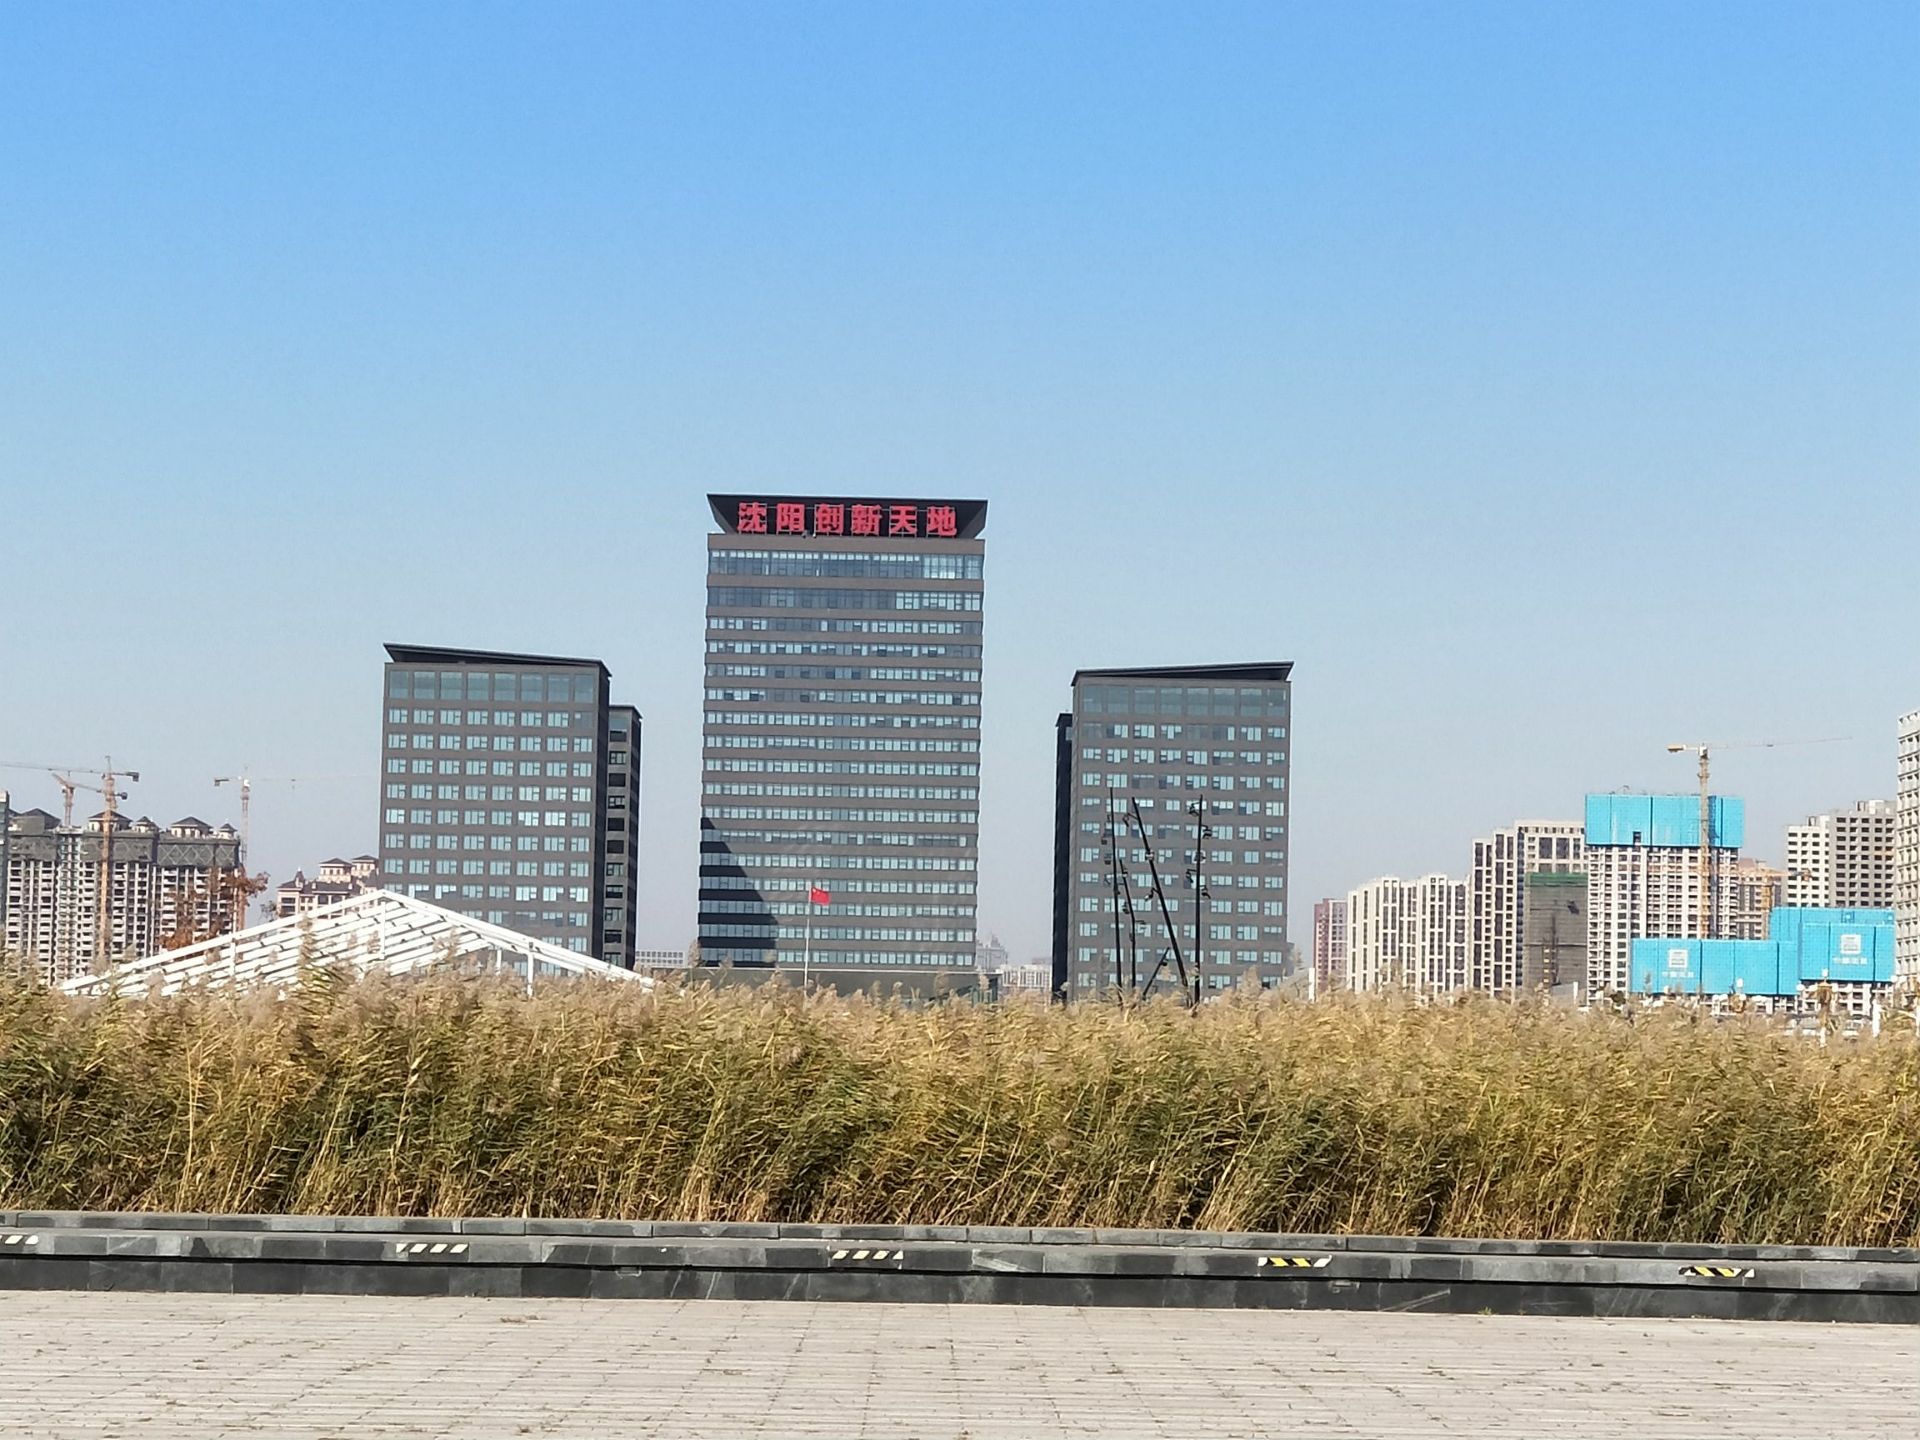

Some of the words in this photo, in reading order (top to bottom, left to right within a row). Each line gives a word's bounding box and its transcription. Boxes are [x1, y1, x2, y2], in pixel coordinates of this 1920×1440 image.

[737, 502, 957, 537] 沈阳创新天地
